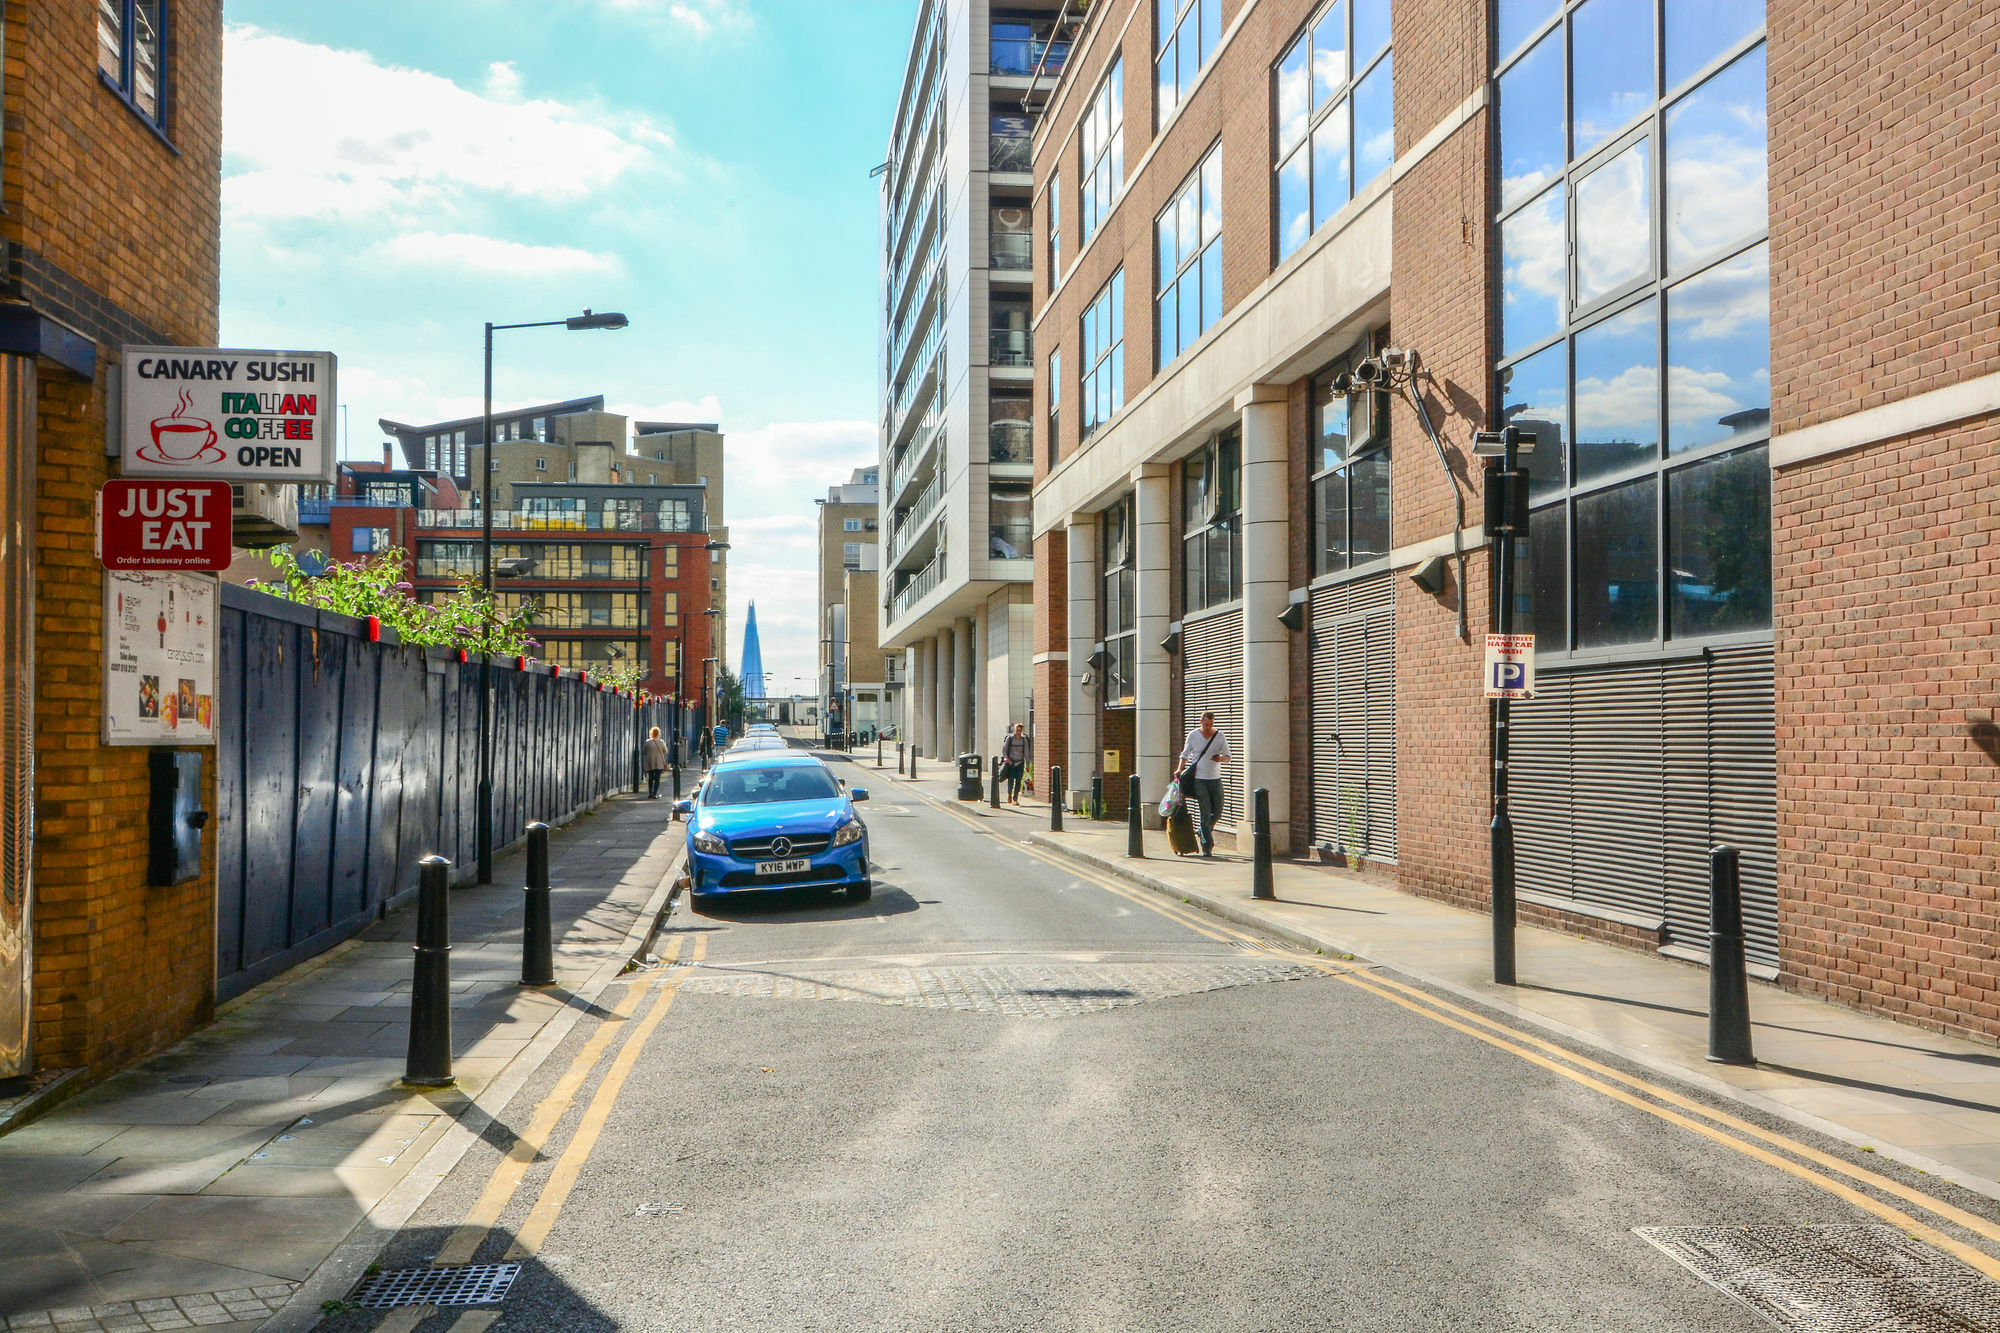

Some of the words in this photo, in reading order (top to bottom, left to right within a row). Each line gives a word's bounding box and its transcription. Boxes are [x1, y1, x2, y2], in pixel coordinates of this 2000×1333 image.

[138, 358, 238, 380] CANARY
[246, 361, 315, 382] SUSHI
[222, 392, 316, 416] ITALIAN
[224, 418, 313, 440] COFFEE
[238, 446, 301, 468] OPEN
[118, 488, 212, 518] JUST
[142, 521, 212, 550] EAT
[142, 556, 183, 566] takeaway
[185, 556, 210, 564] online
[1498, 664, 1520, 688] P
[762, 862, 783, 872] KY16
[786, 860, 804, 871] MWP
